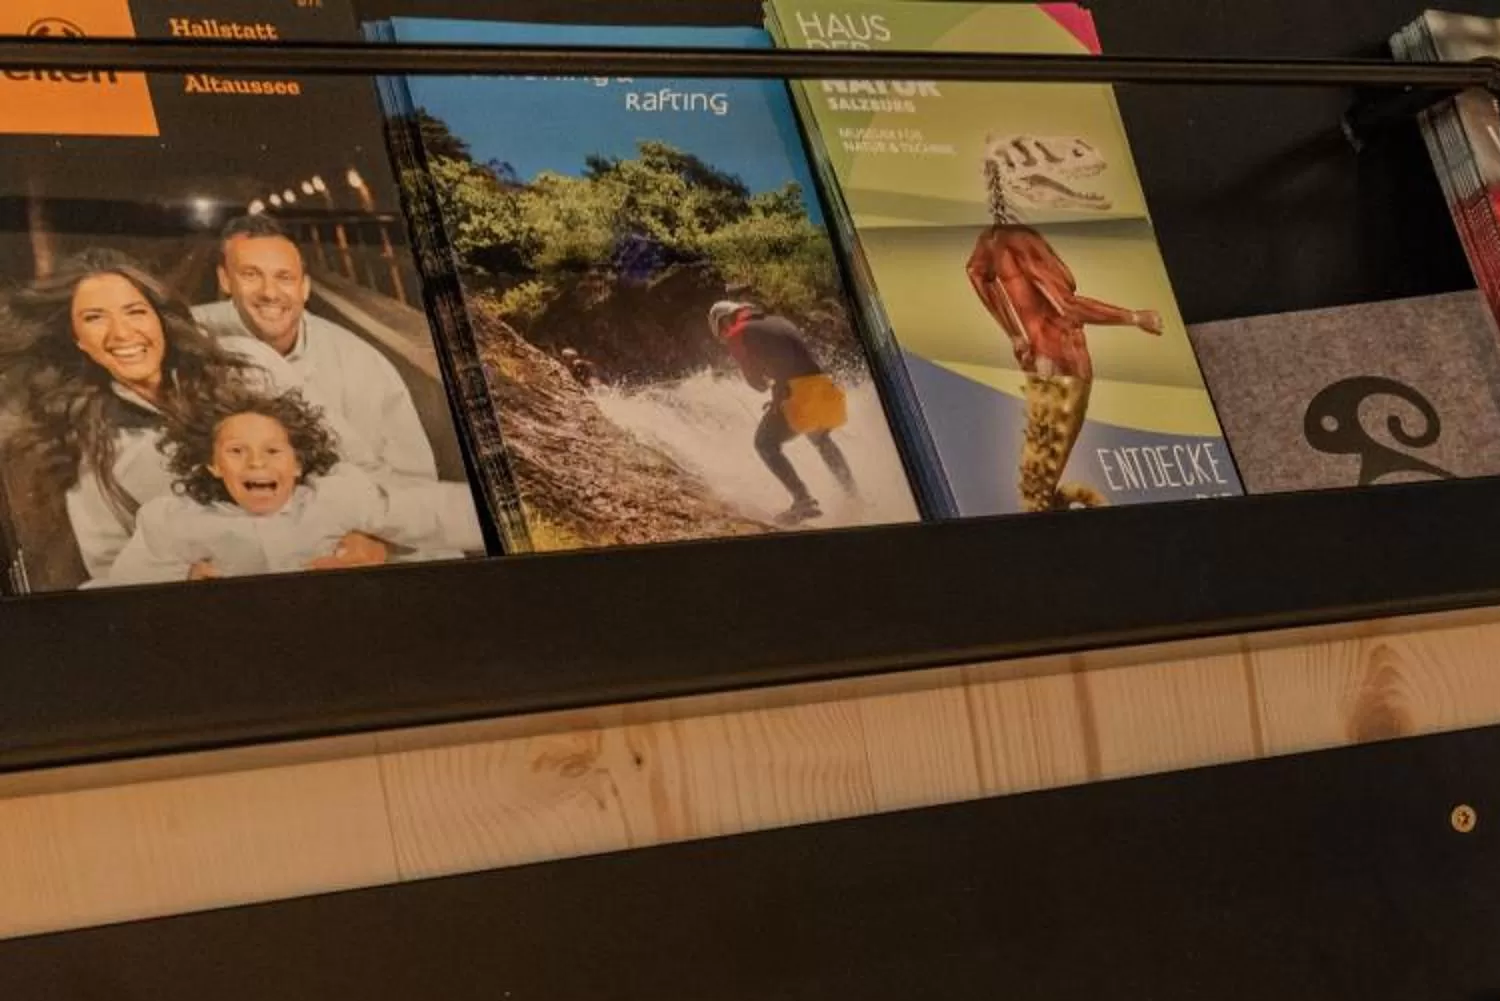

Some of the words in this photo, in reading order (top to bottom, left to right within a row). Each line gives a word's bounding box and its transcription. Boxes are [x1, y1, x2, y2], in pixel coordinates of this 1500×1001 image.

[168, 18, 280, 41] Hallstatt
[795, 11, 892, 42] HAUS
[184, 74, 301, 97] Altaussee
[1097, 442, 1228, 492] ENTDECKE
